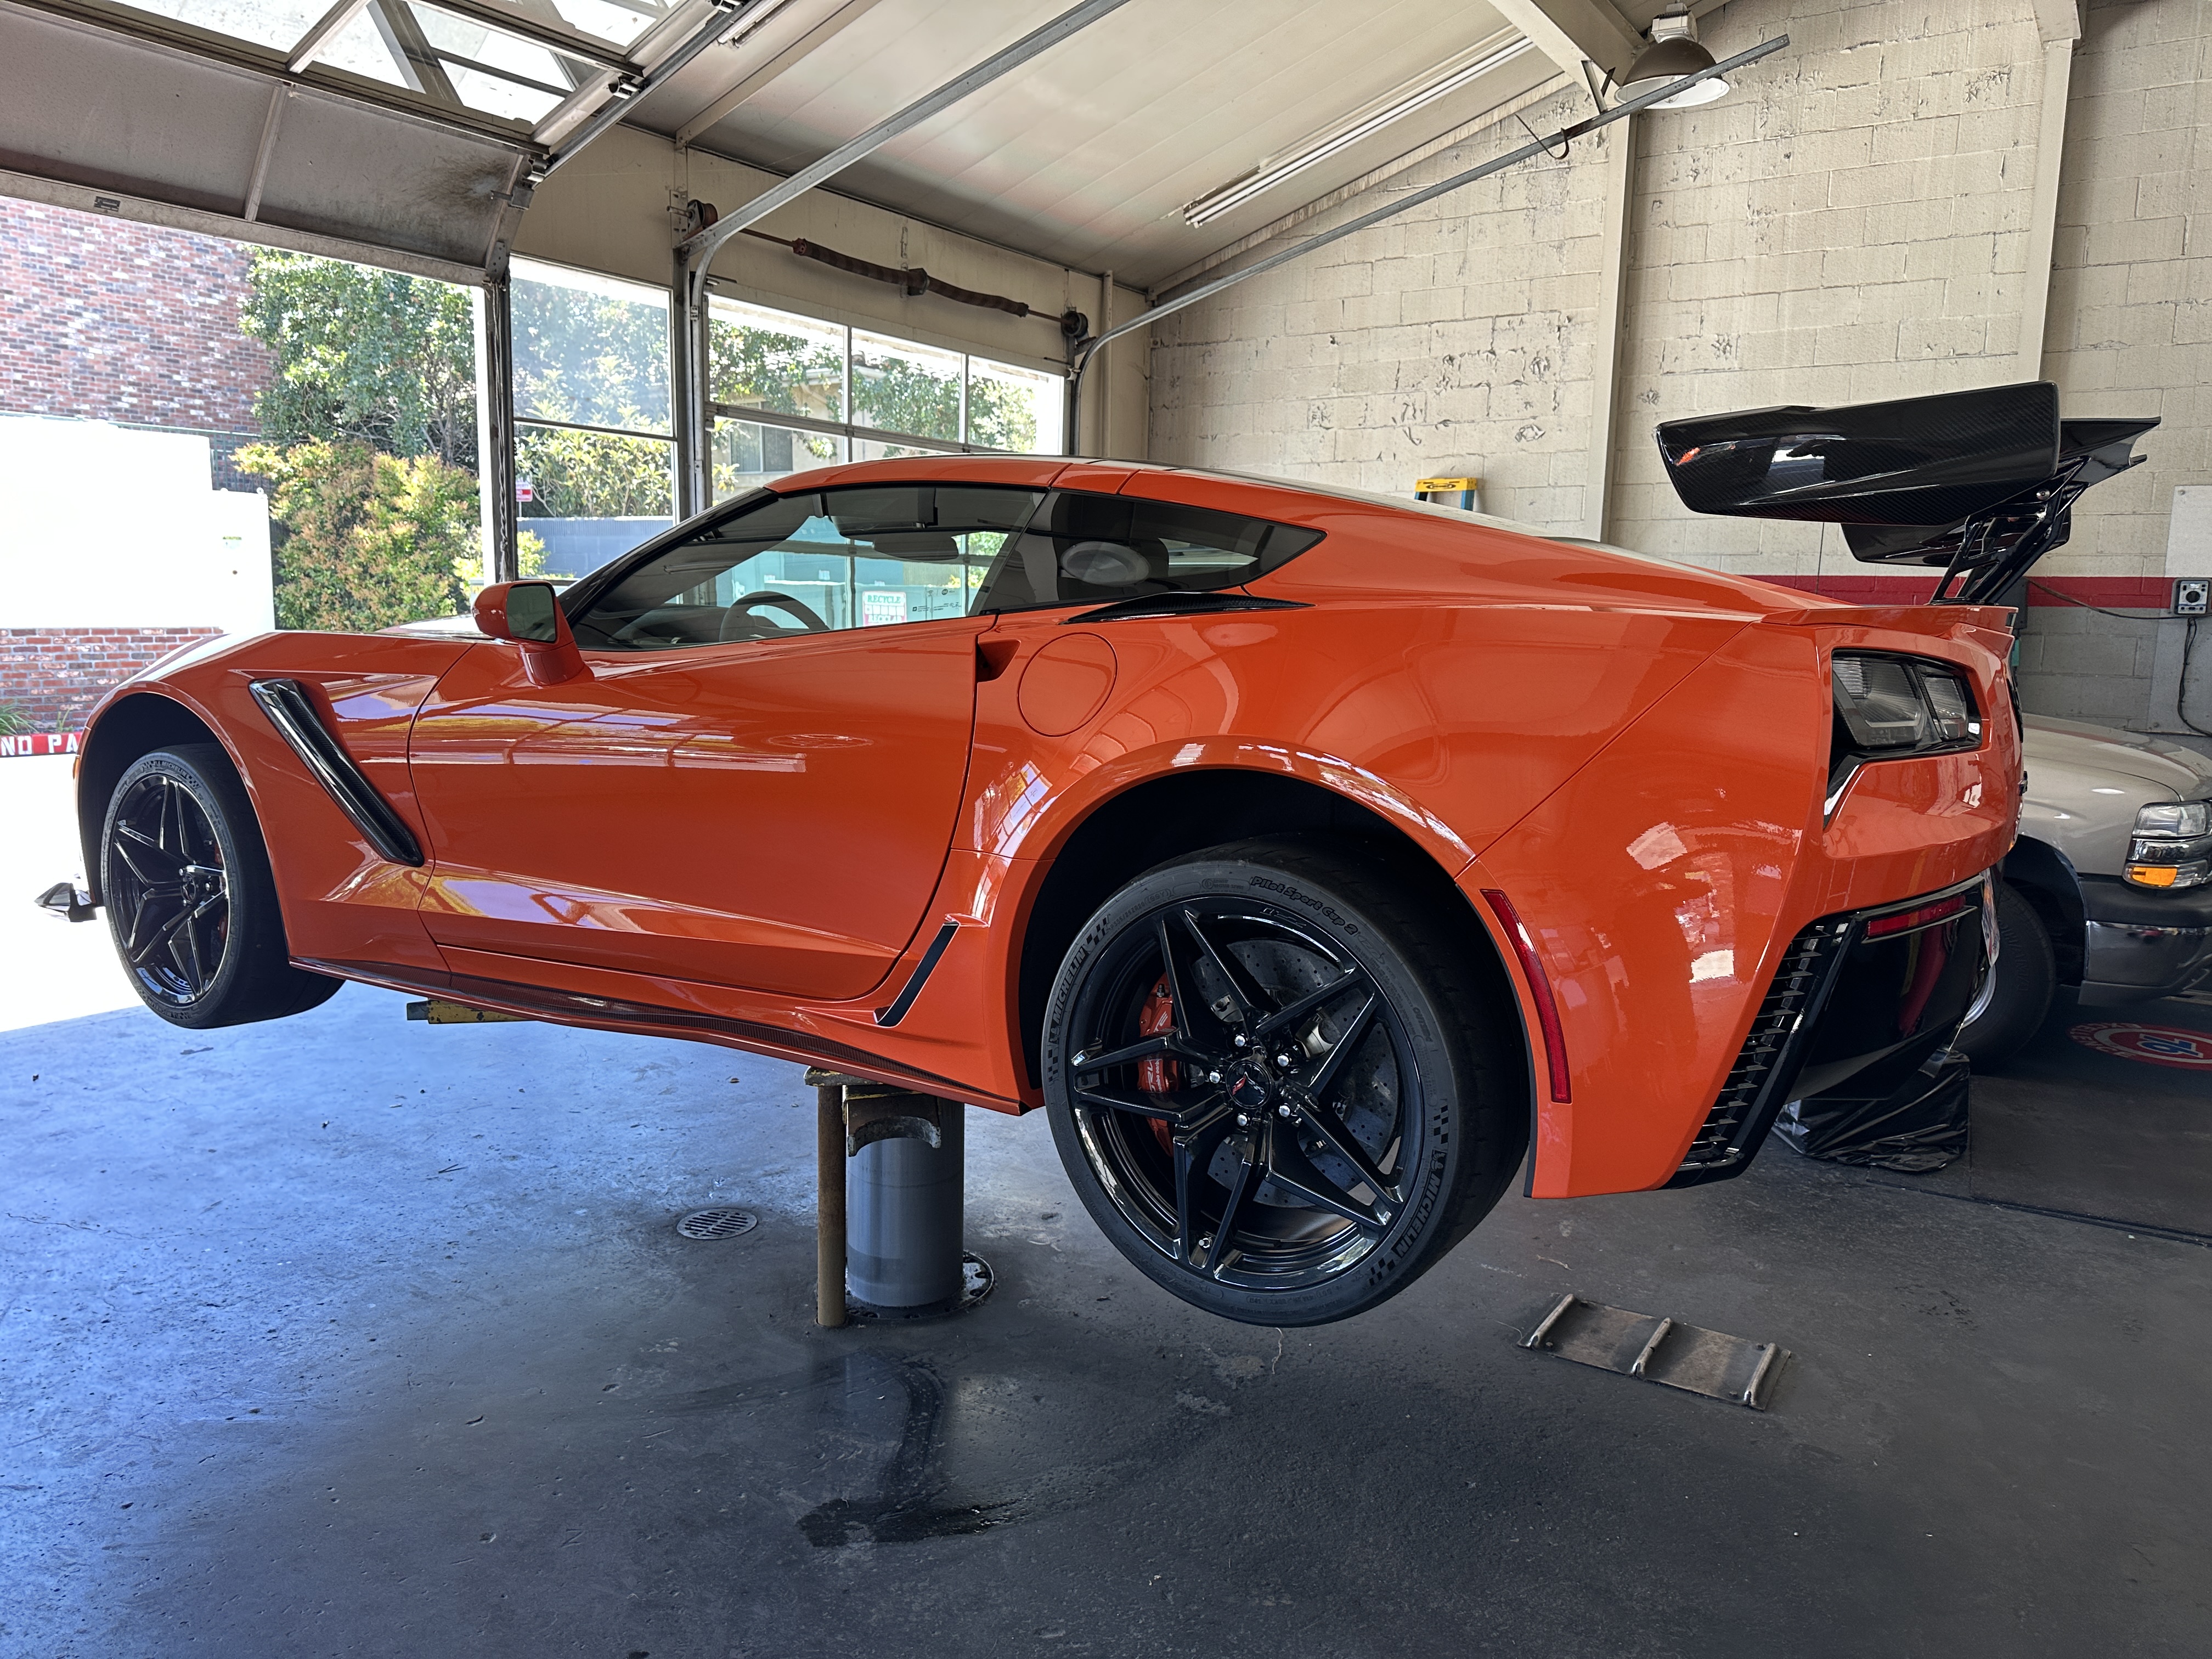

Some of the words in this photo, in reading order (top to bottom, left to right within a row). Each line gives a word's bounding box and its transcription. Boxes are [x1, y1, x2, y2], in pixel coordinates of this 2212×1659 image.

[867, 595, 901, 603] RECYCLE
[1, 735, 32, 756] NO
[161, 761, 188, 778] MICHELIN
[1284, 887, 1323, 911] Sport
[1322, 907, 1346, 926] Cup
[1344, 923, 1358, 935] 2
[1053, 947, 1086, 1024] MICHELIN
[2136, 1032, 2204, 1059] 76
[1396, 1172, 1441, 1257] MICHELIN
